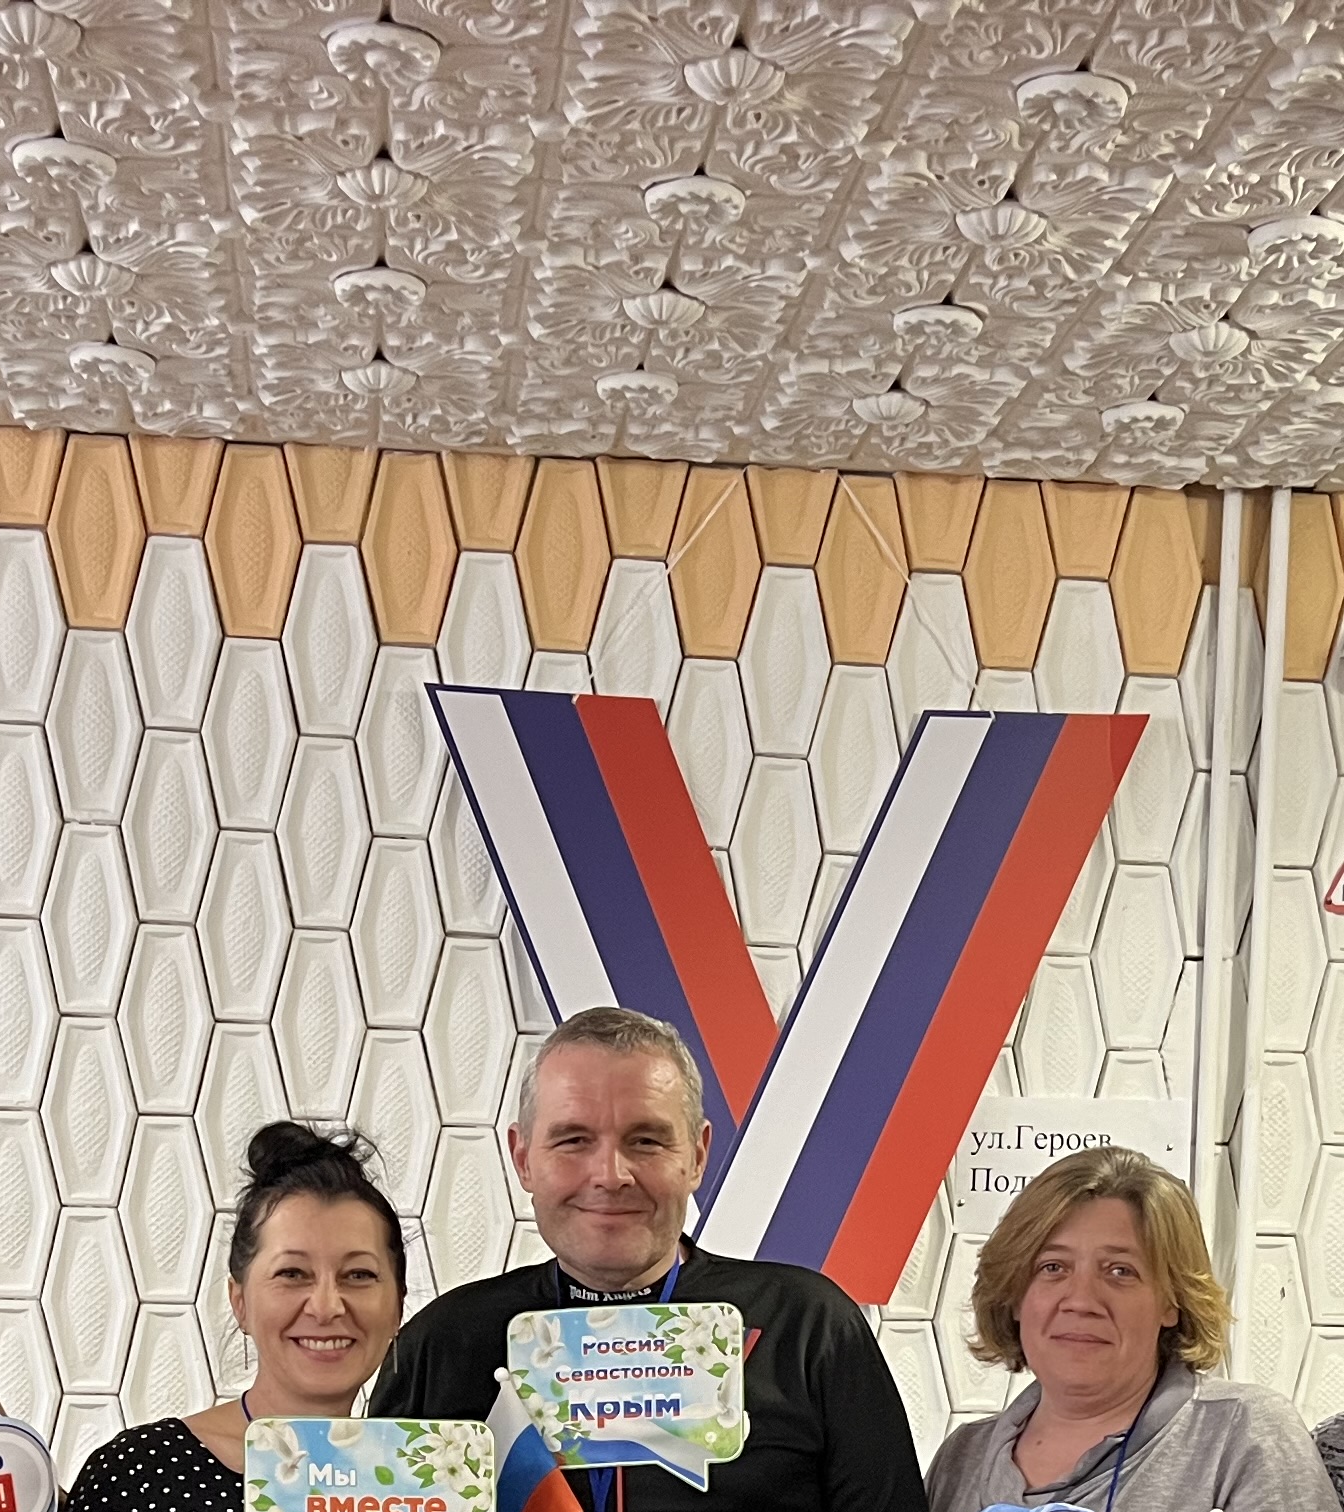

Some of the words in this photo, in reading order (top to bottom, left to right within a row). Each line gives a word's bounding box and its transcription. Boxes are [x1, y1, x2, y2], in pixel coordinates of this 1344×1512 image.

[970, 1125, 1112, 1157] ул.Героев
[970, 1167, 1033, 1196] Под
[582, 1335, 666, 1356] Россия
[555, 1364, 694, 1384] Севастополь
[568, 1389, 682, 1429] Крым
[308, 1463, 357, 1487] Мы
